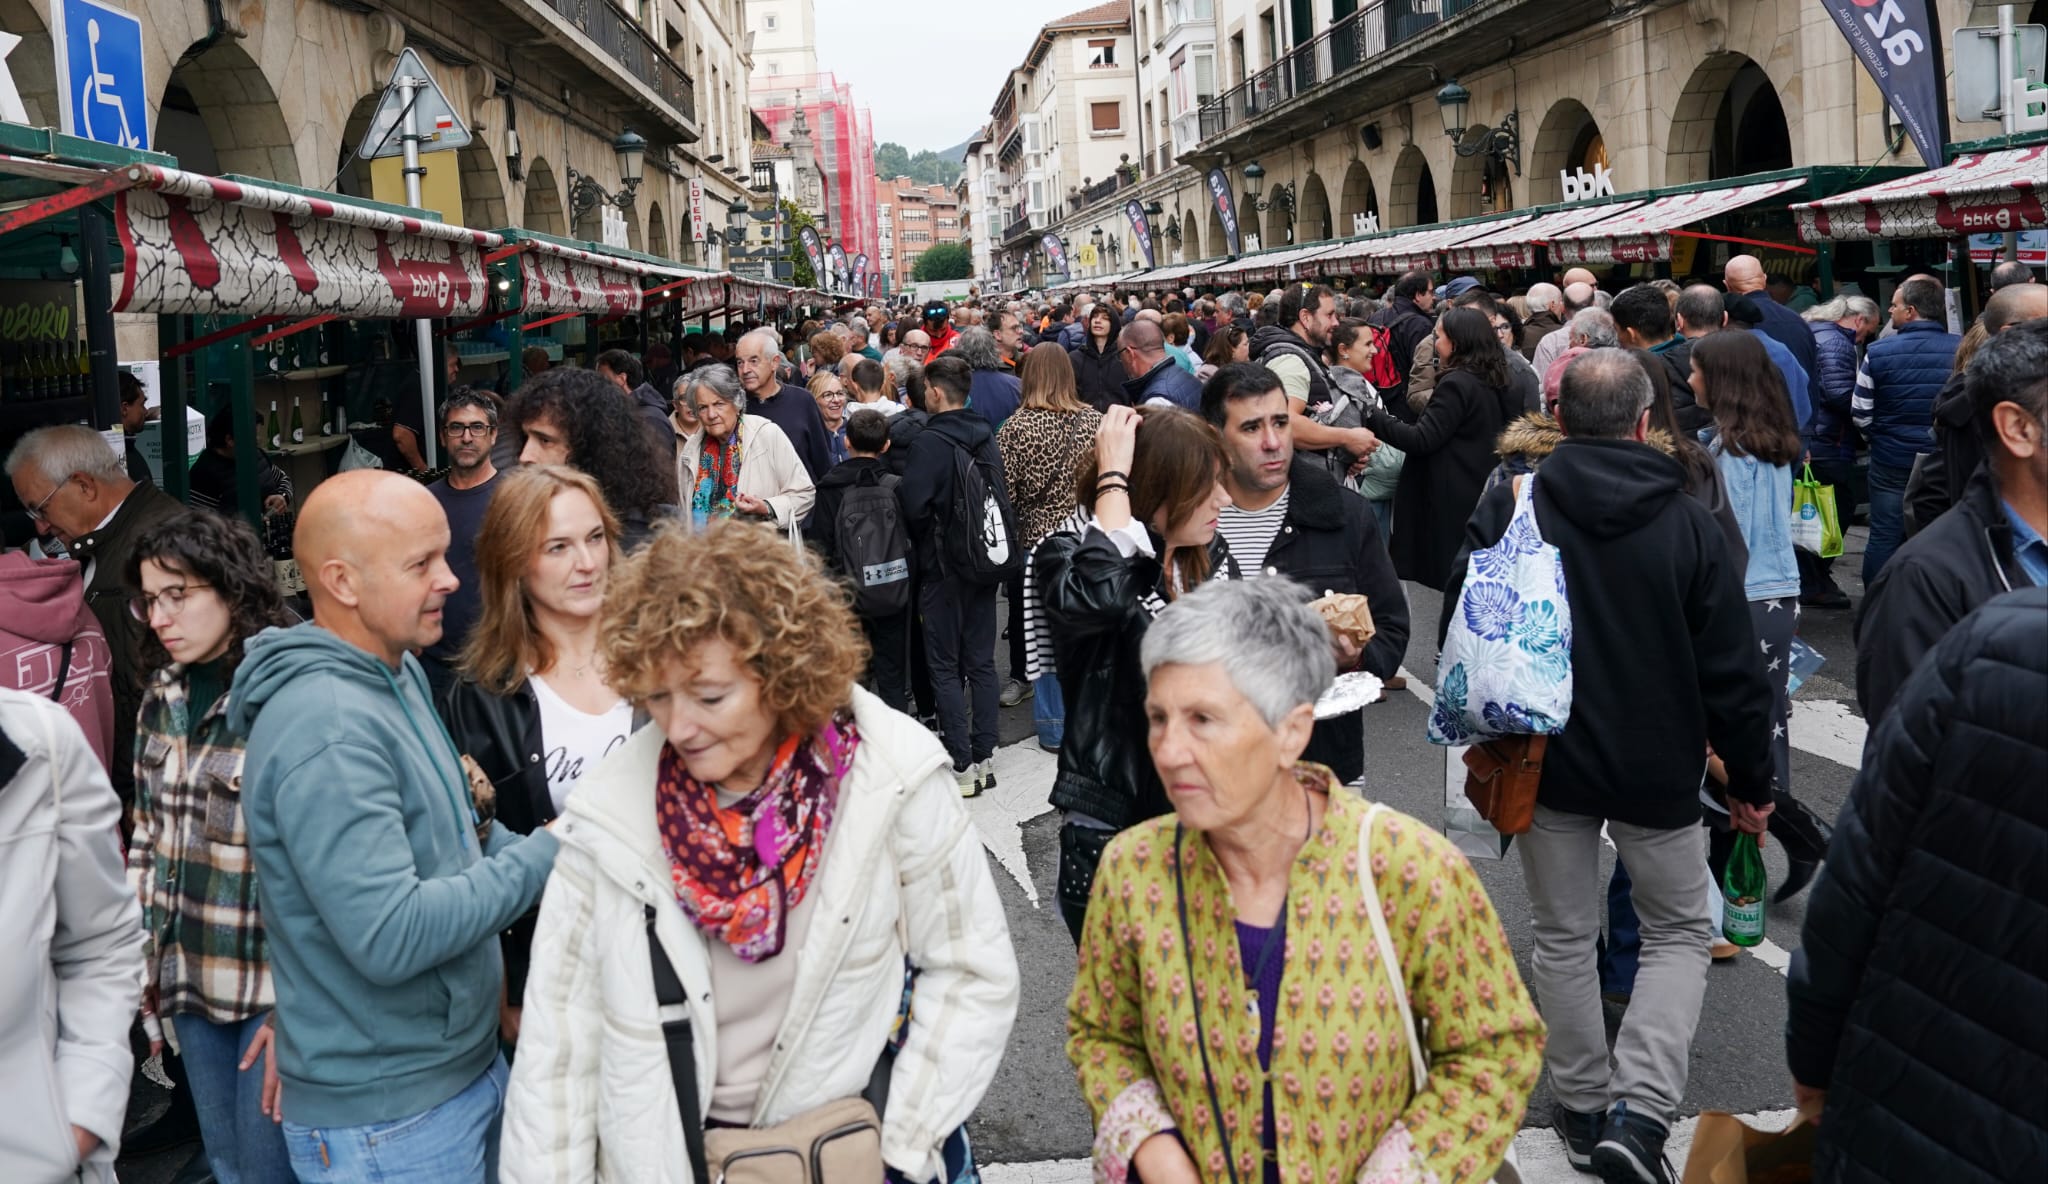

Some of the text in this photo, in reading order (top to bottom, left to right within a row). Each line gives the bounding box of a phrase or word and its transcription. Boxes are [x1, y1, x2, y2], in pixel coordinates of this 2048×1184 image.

[1560, 162, 1615, 202] bbk
[691, 181, 703, 239] LOTERIA
[1353, 210, 1379, 237] bbk
